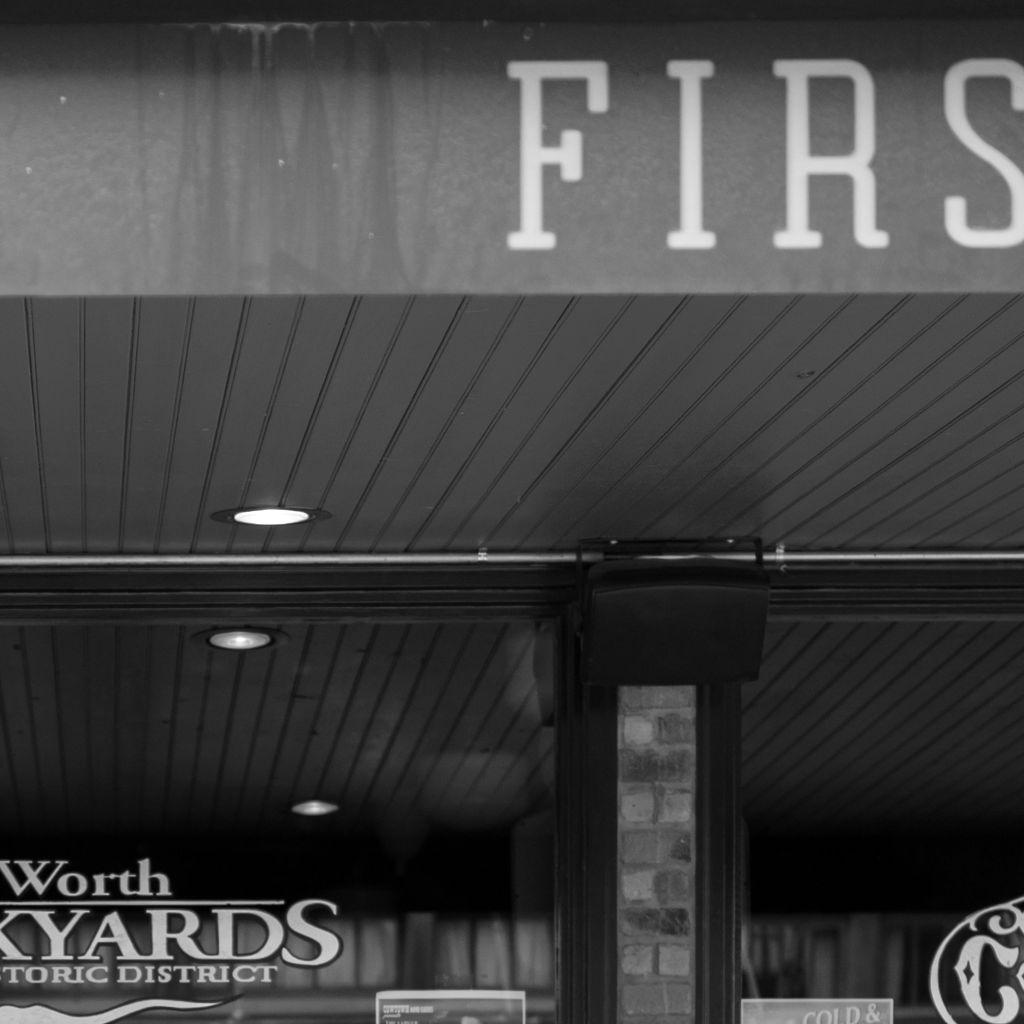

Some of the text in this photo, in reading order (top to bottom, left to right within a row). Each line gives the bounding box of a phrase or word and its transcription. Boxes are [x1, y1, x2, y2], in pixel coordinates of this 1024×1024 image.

[507, 58, 1024, 250] FIRS
[118, 965, 279, 984] DISTRICT
[866, 1003, 880, 1024] &
